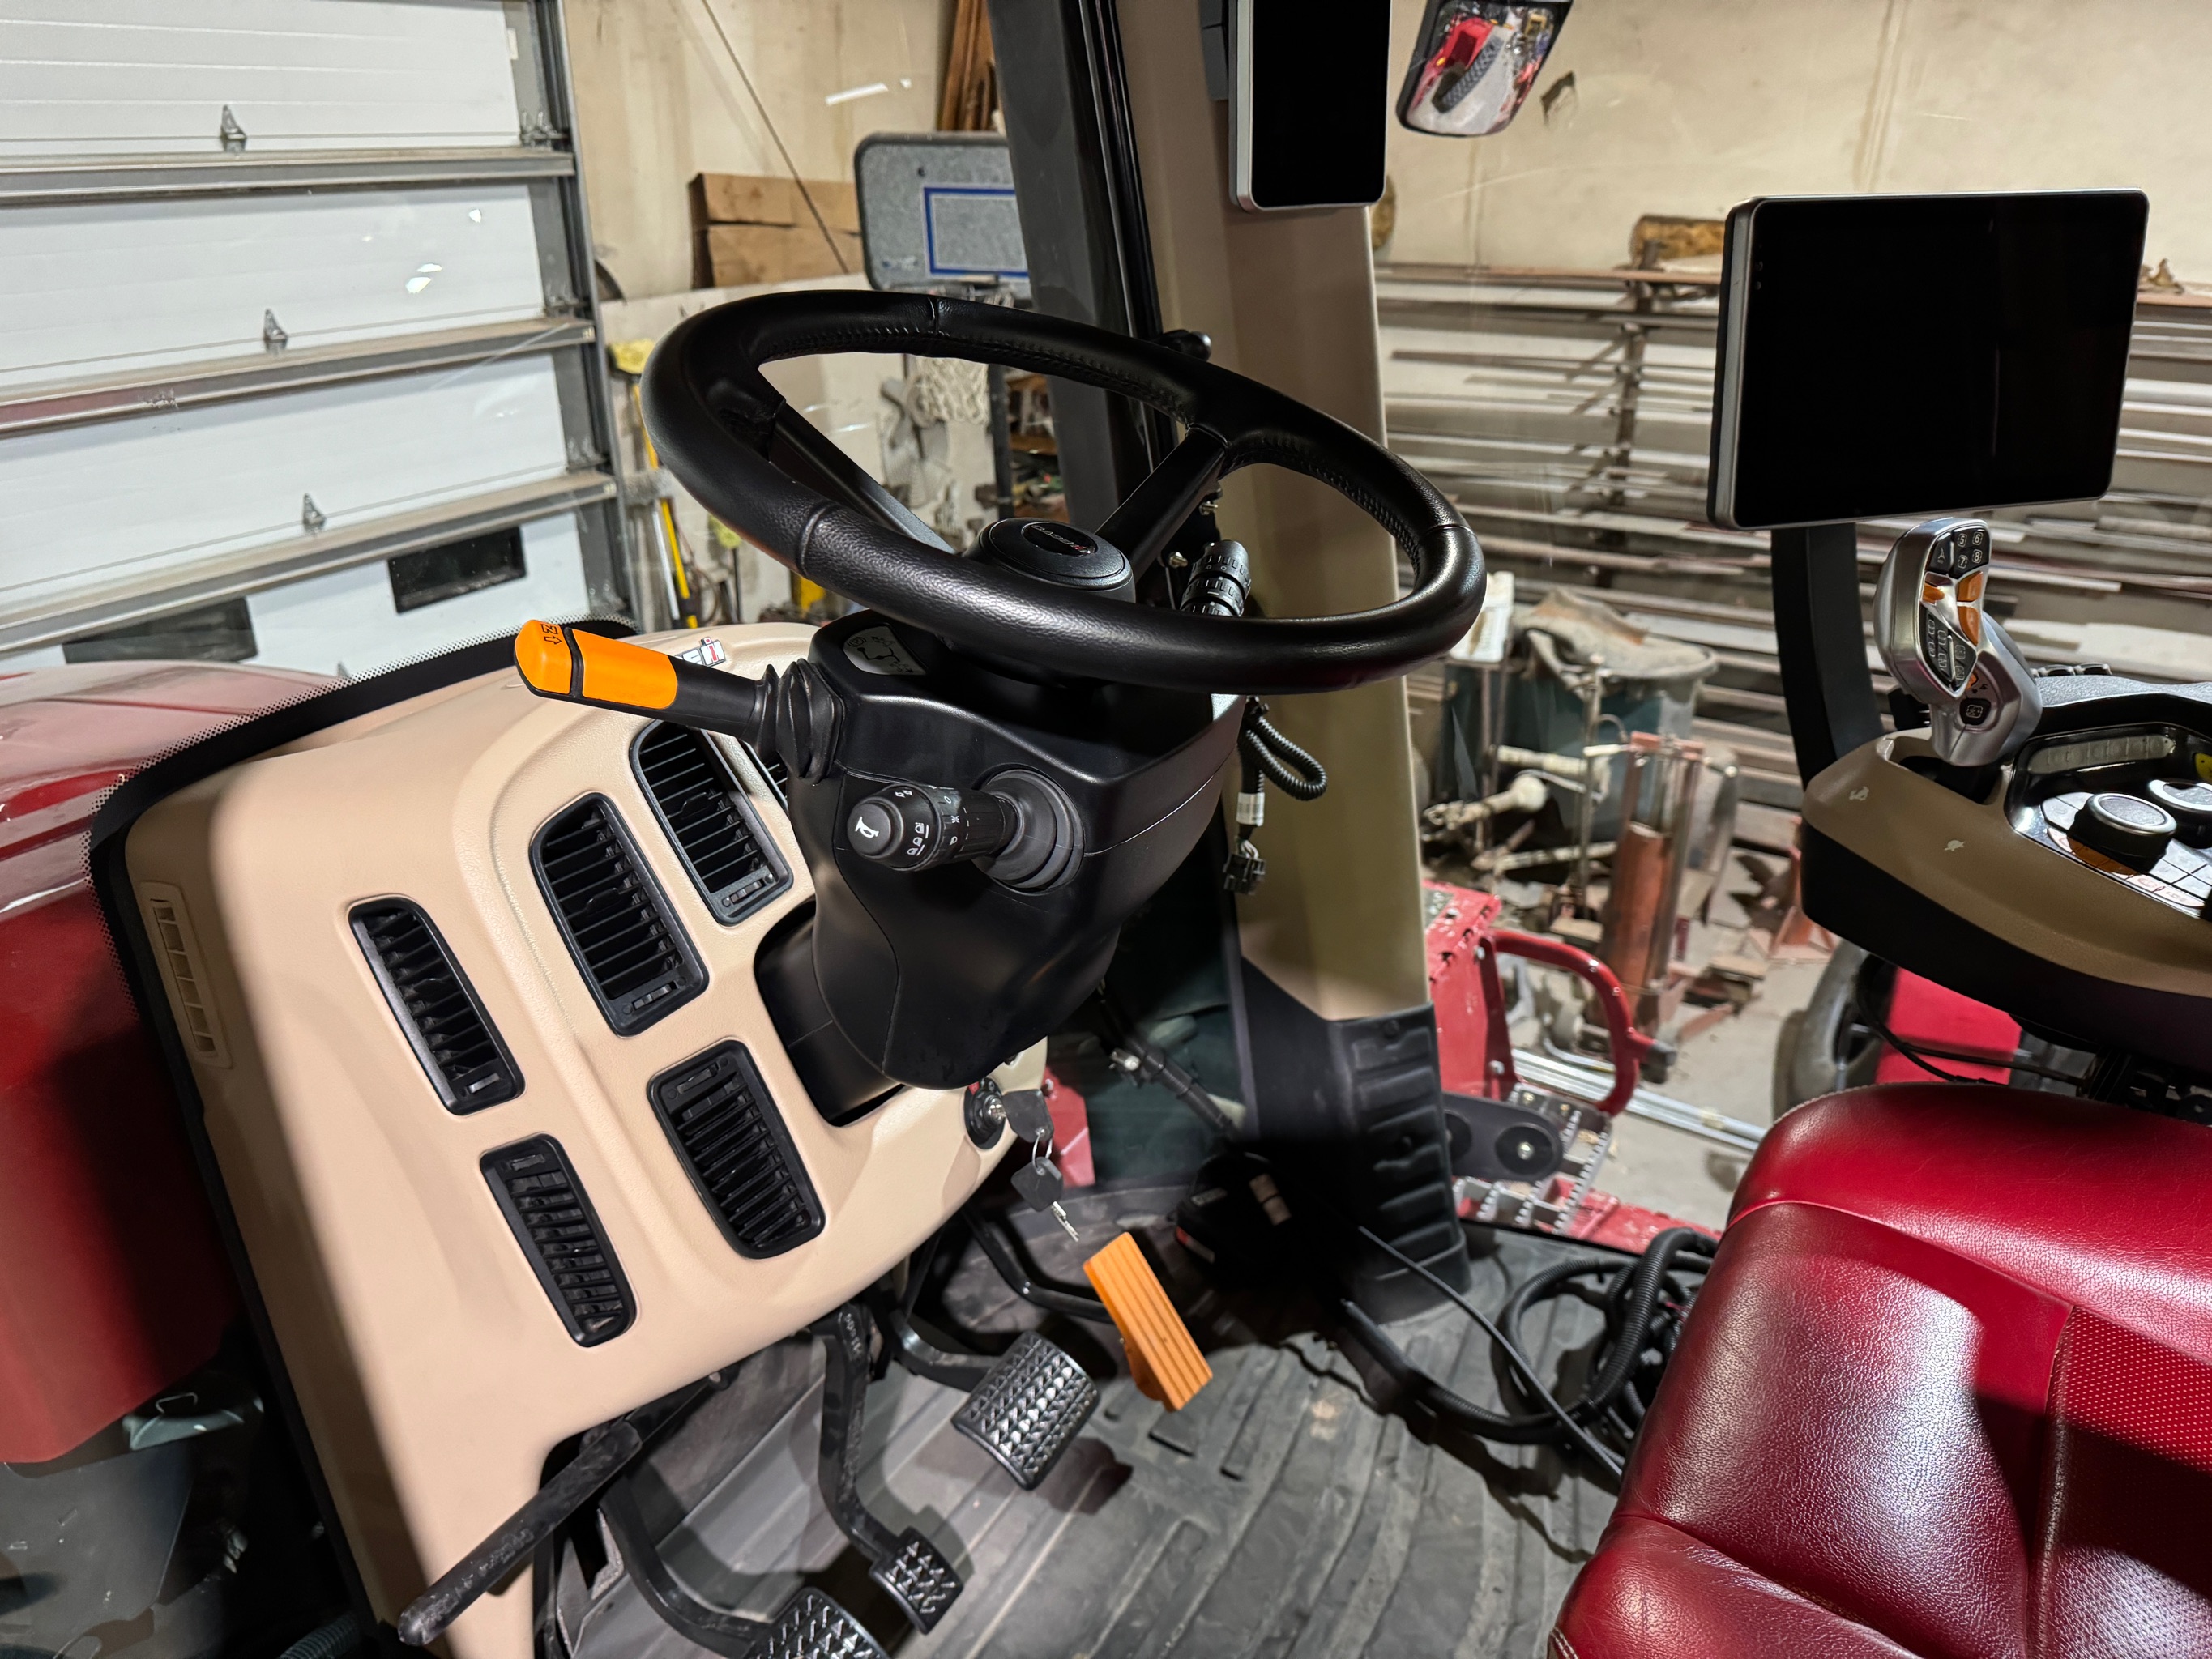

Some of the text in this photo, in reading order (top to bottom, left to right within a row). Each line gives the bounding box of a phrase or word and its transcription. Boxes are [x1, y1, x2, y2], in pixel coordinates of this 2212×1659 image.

[1959, 533, 1982, 545] 5 6
[1960, 552, 1980, 566] 7 8
